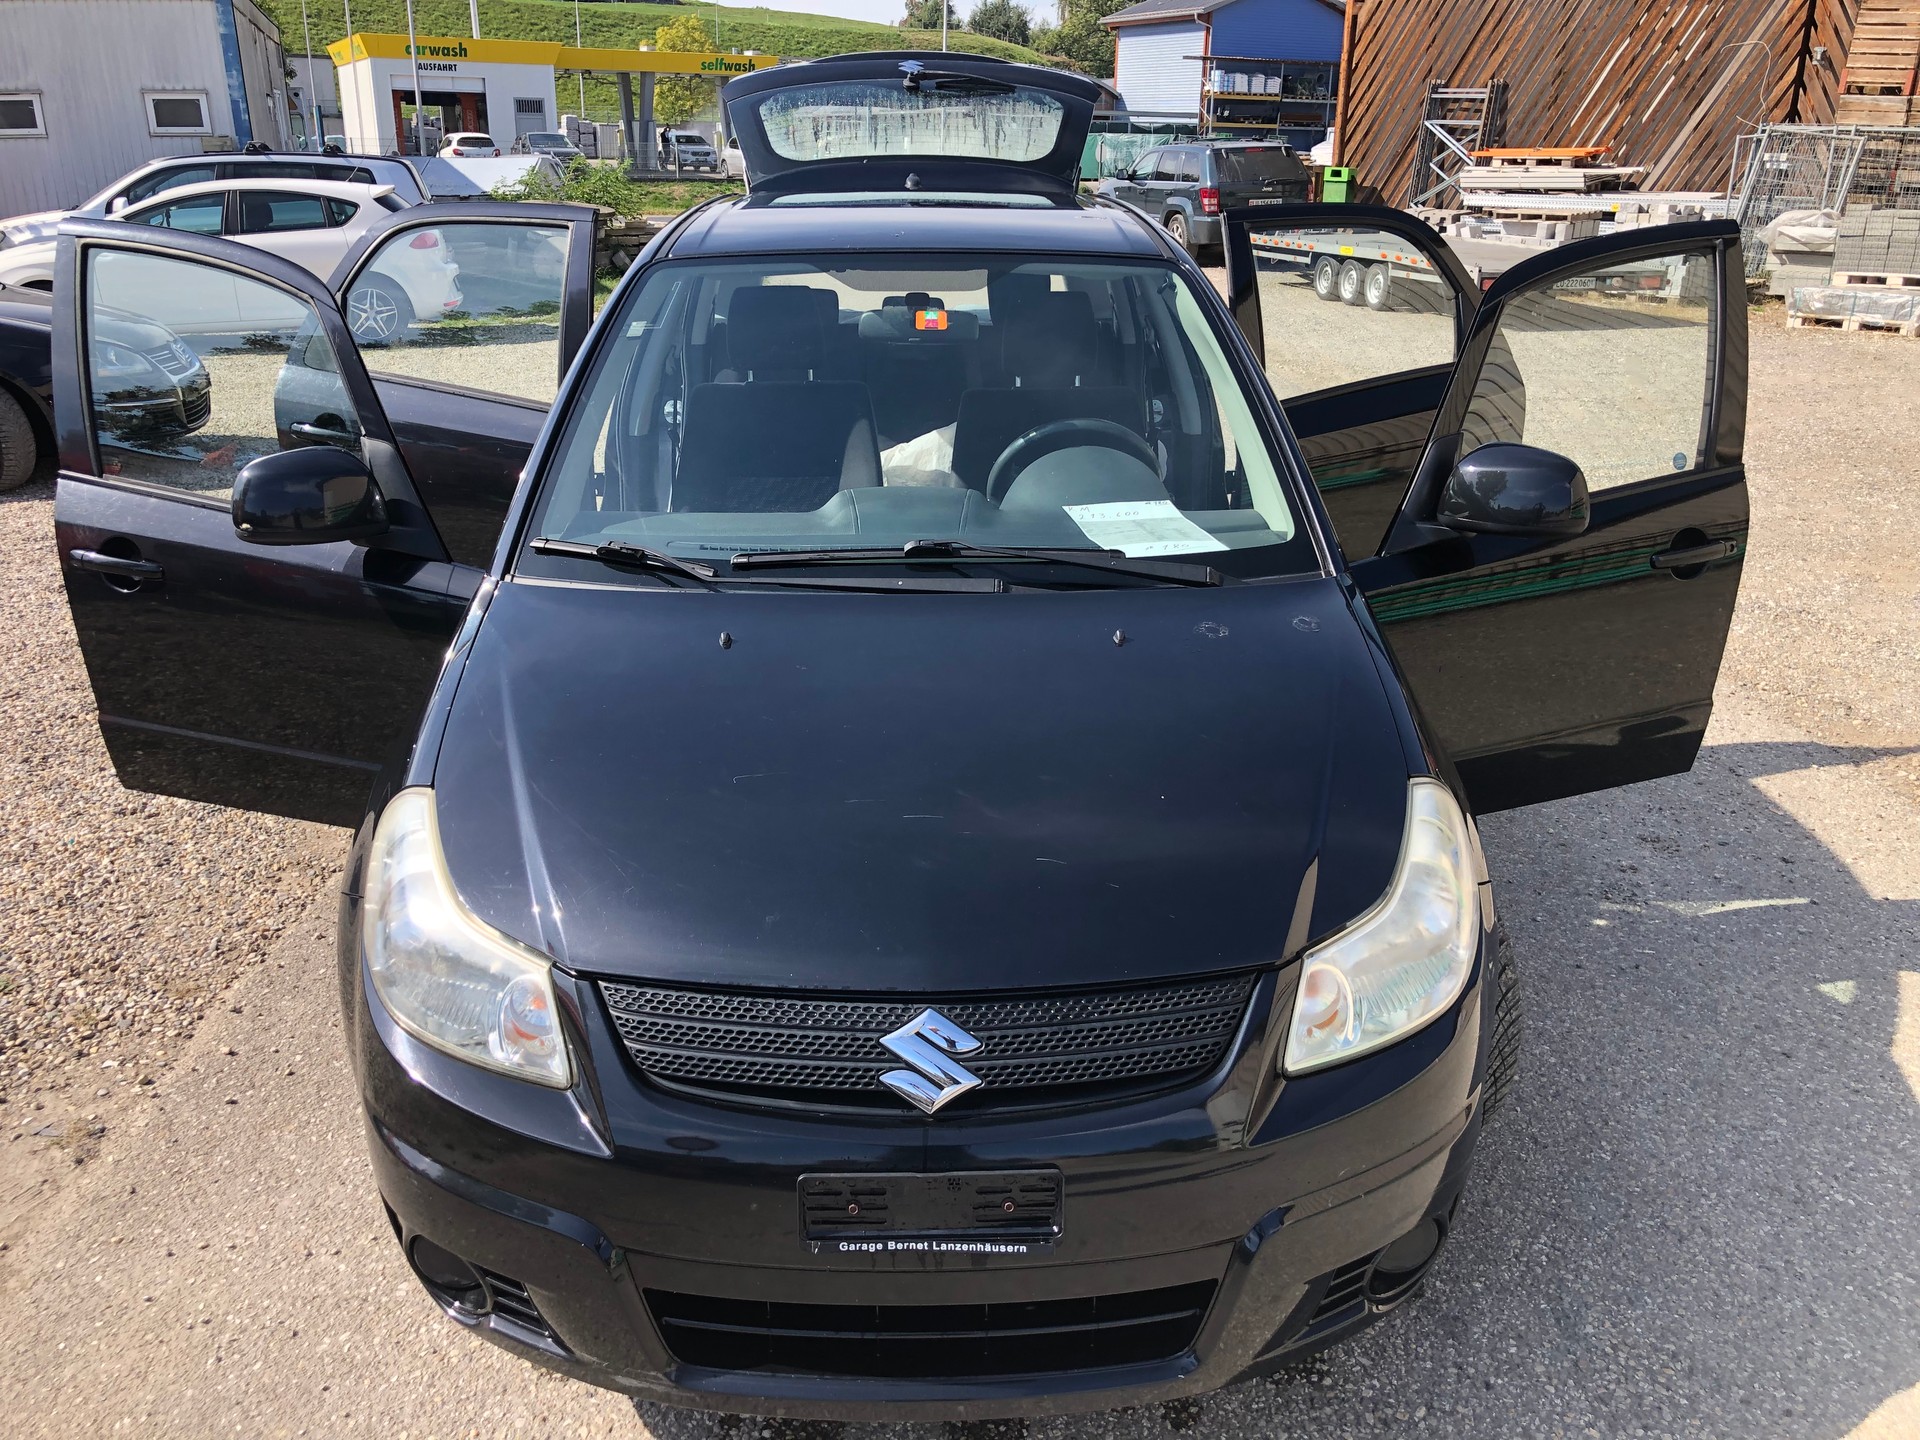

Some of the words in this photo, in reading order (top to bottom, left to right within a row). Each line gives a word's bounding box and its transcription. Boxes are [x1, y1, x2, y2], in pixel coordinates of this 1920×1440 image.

[418, 62, 458, 72] AUSFAHRT
[701, 57, 756, 73] selfwash
[839, 1241, 883, 1252] Garage
[887, 1241, 929, 1250] Bernet
[932, 1241, 1027, 1253] Lanzenhäusern
